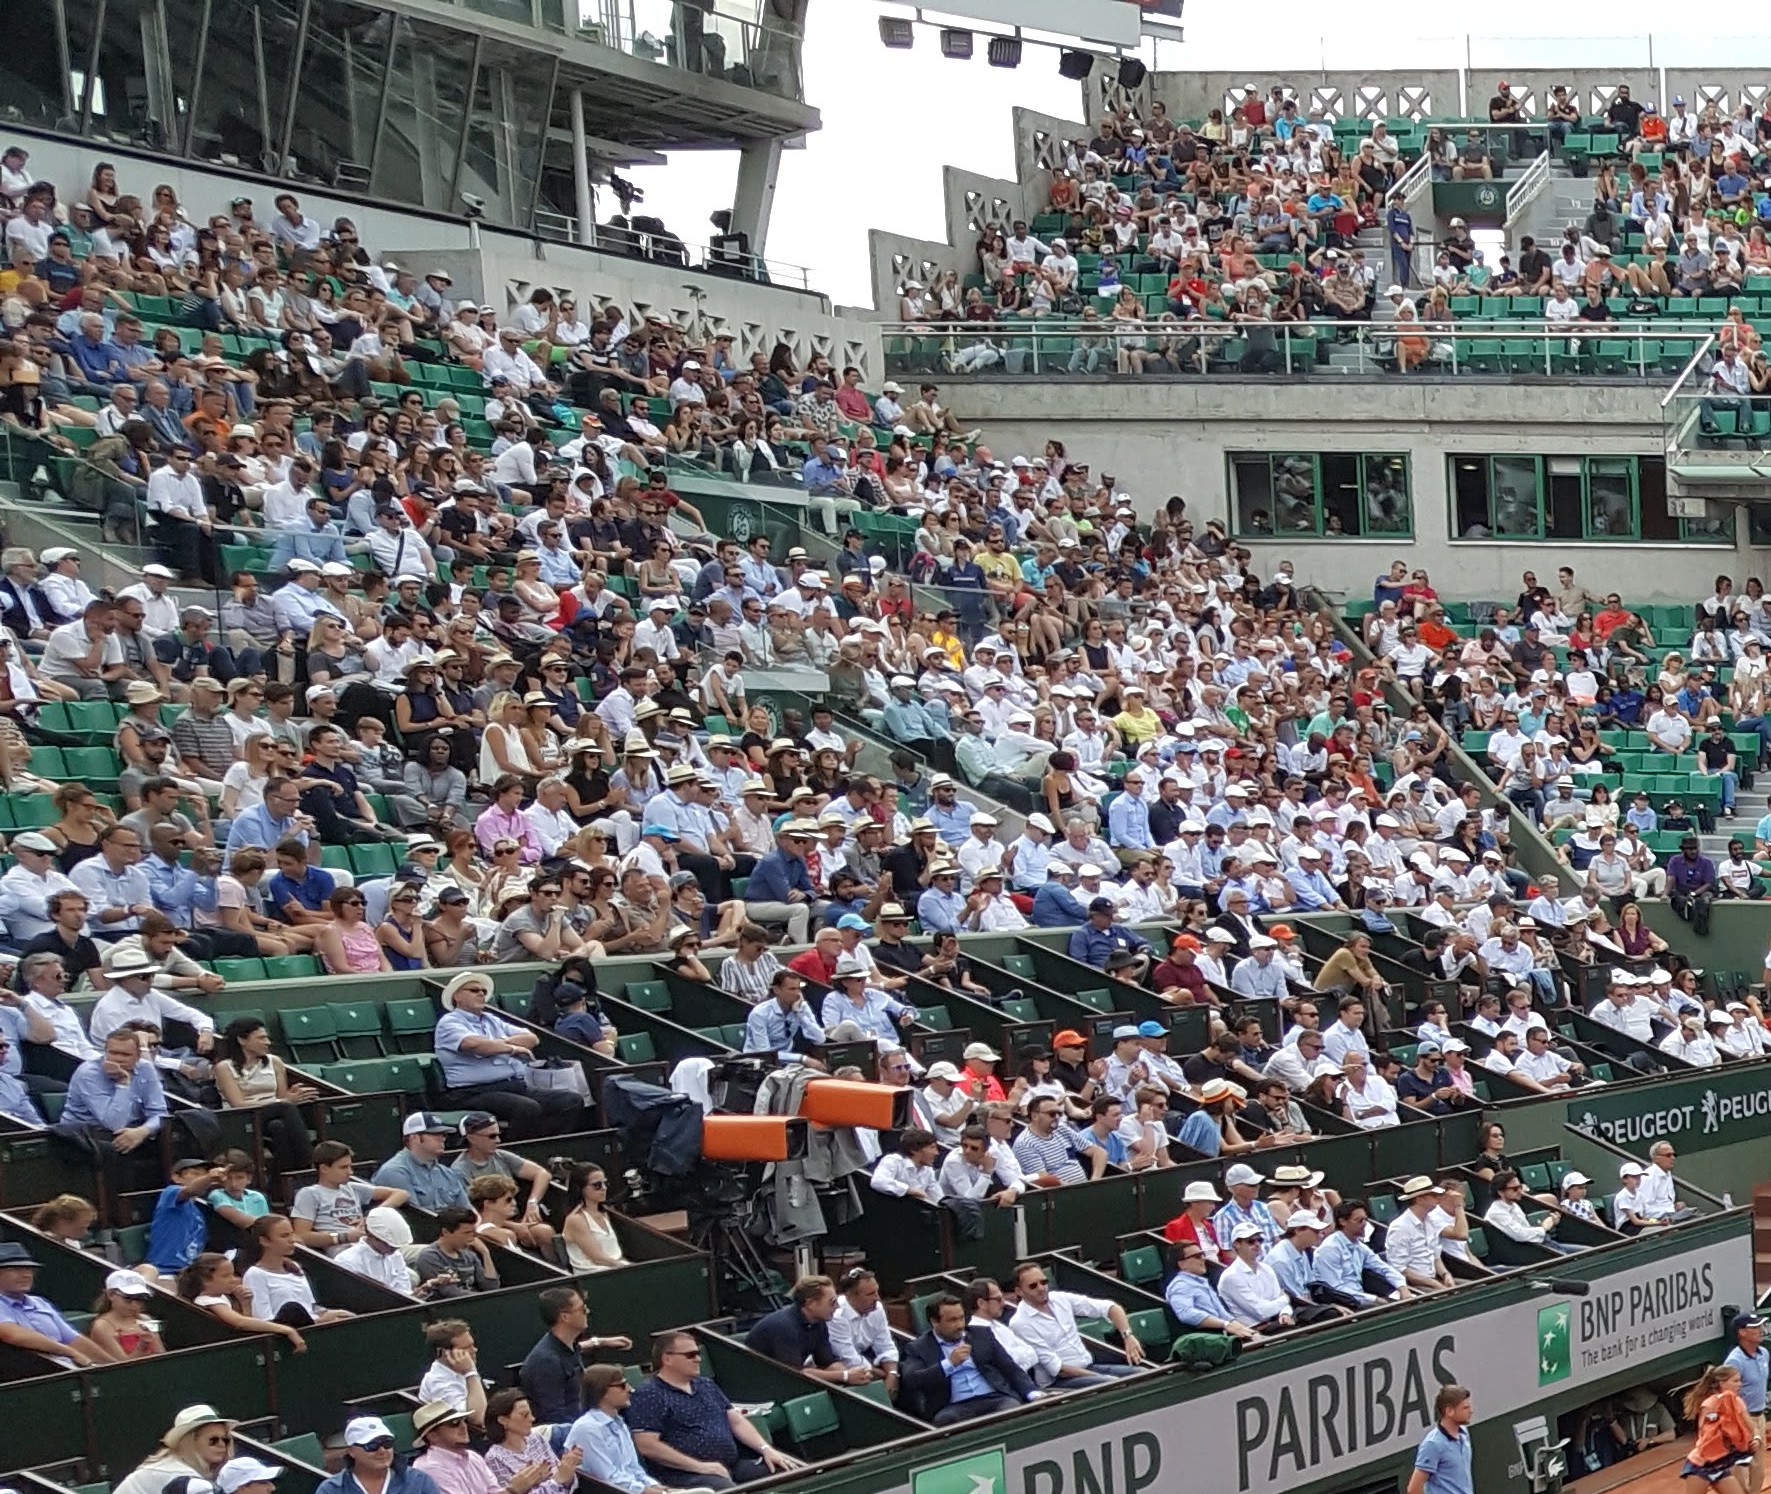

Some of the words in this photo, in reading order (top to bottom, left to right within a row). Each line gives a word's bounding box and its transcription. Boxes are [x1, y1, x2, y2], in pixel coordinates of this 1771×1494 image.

[1600, 1105, 1695, 1145] PEUGEOT
[1581, 1291, 1624, 1343] BNP
[1630, 1262, 1714, 1327] PARIBAS
[1582, 1350, 1599, 1368] The
